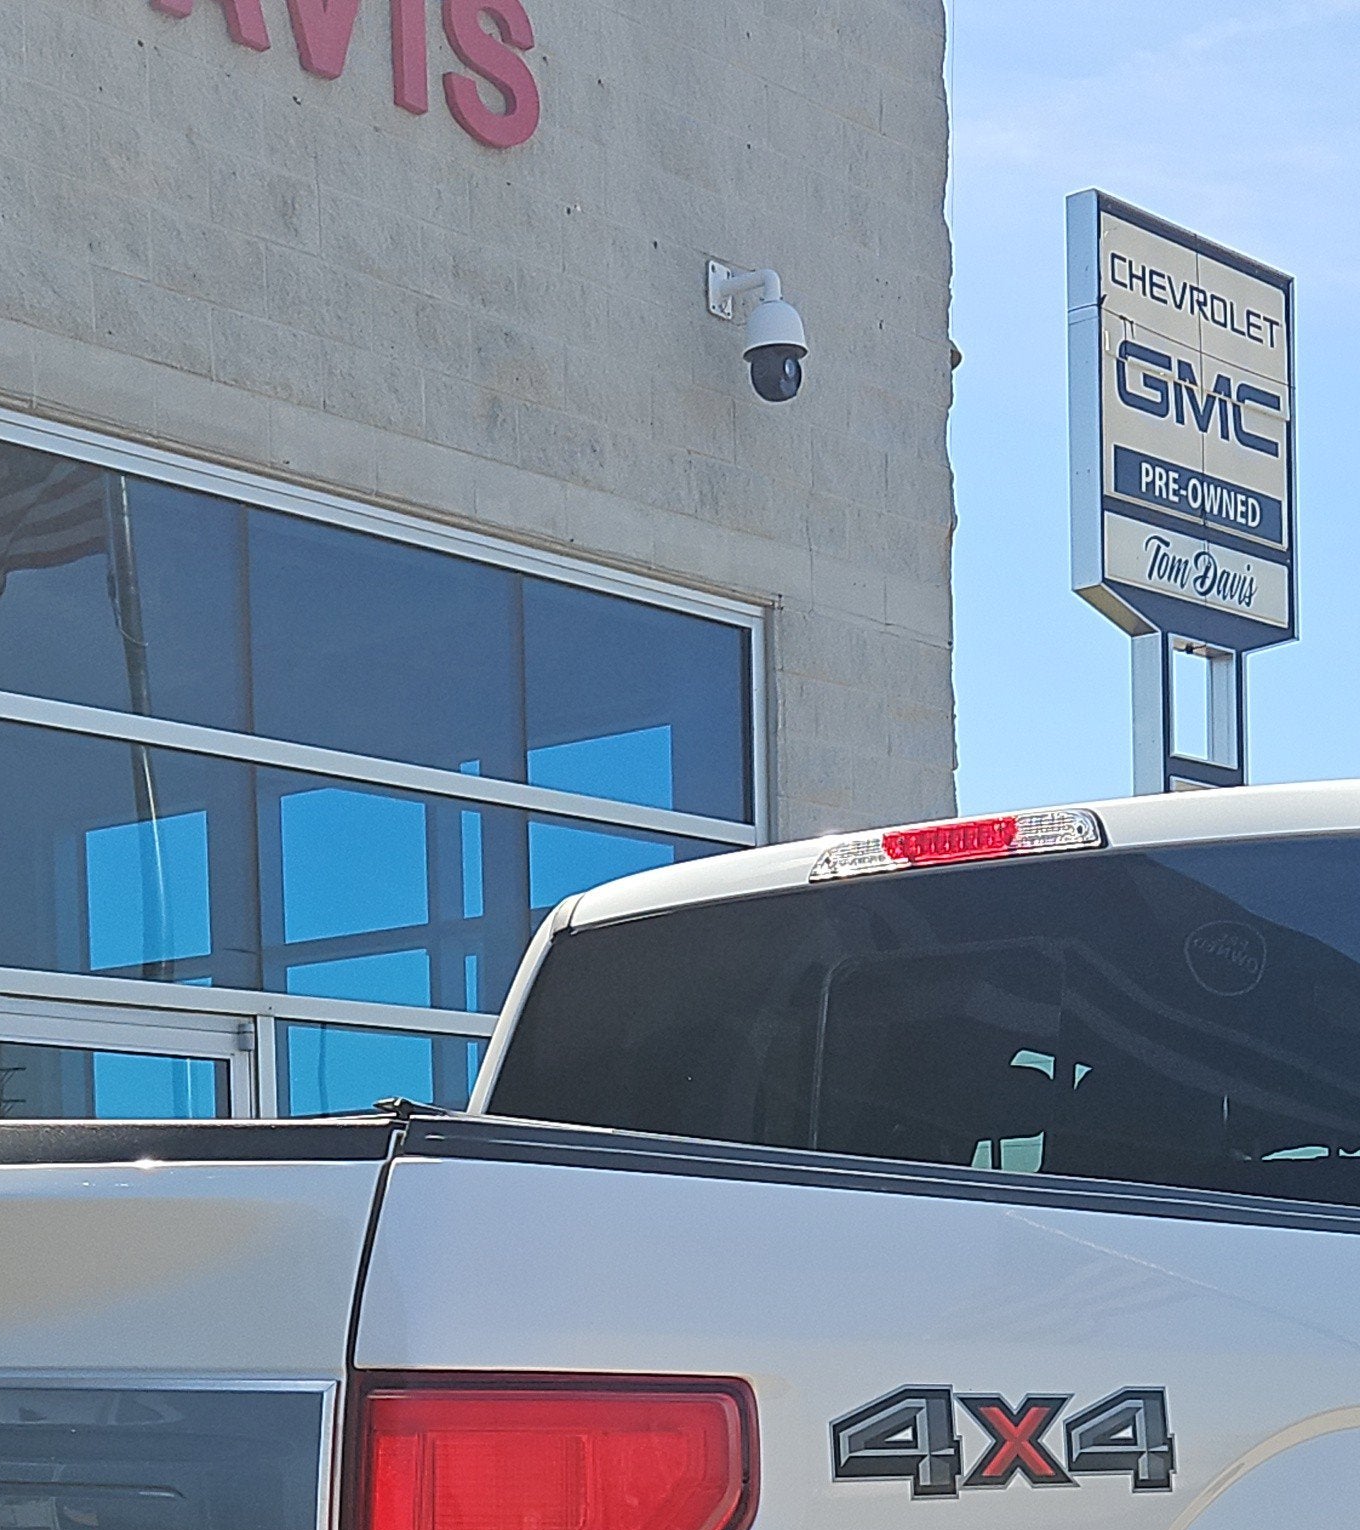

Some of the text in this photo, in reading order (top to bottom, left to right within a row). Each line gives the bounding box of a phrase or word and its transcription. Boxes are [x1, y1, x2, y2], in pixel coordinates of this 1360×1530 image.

[1110, 252, 1281, 348] CHEVROLET
[1116, 340, 1280, 458] GMC
[1141, 461, 1261, 528] PRE-OWNED
[1144, 534, 1258, 607] Tom Davis
